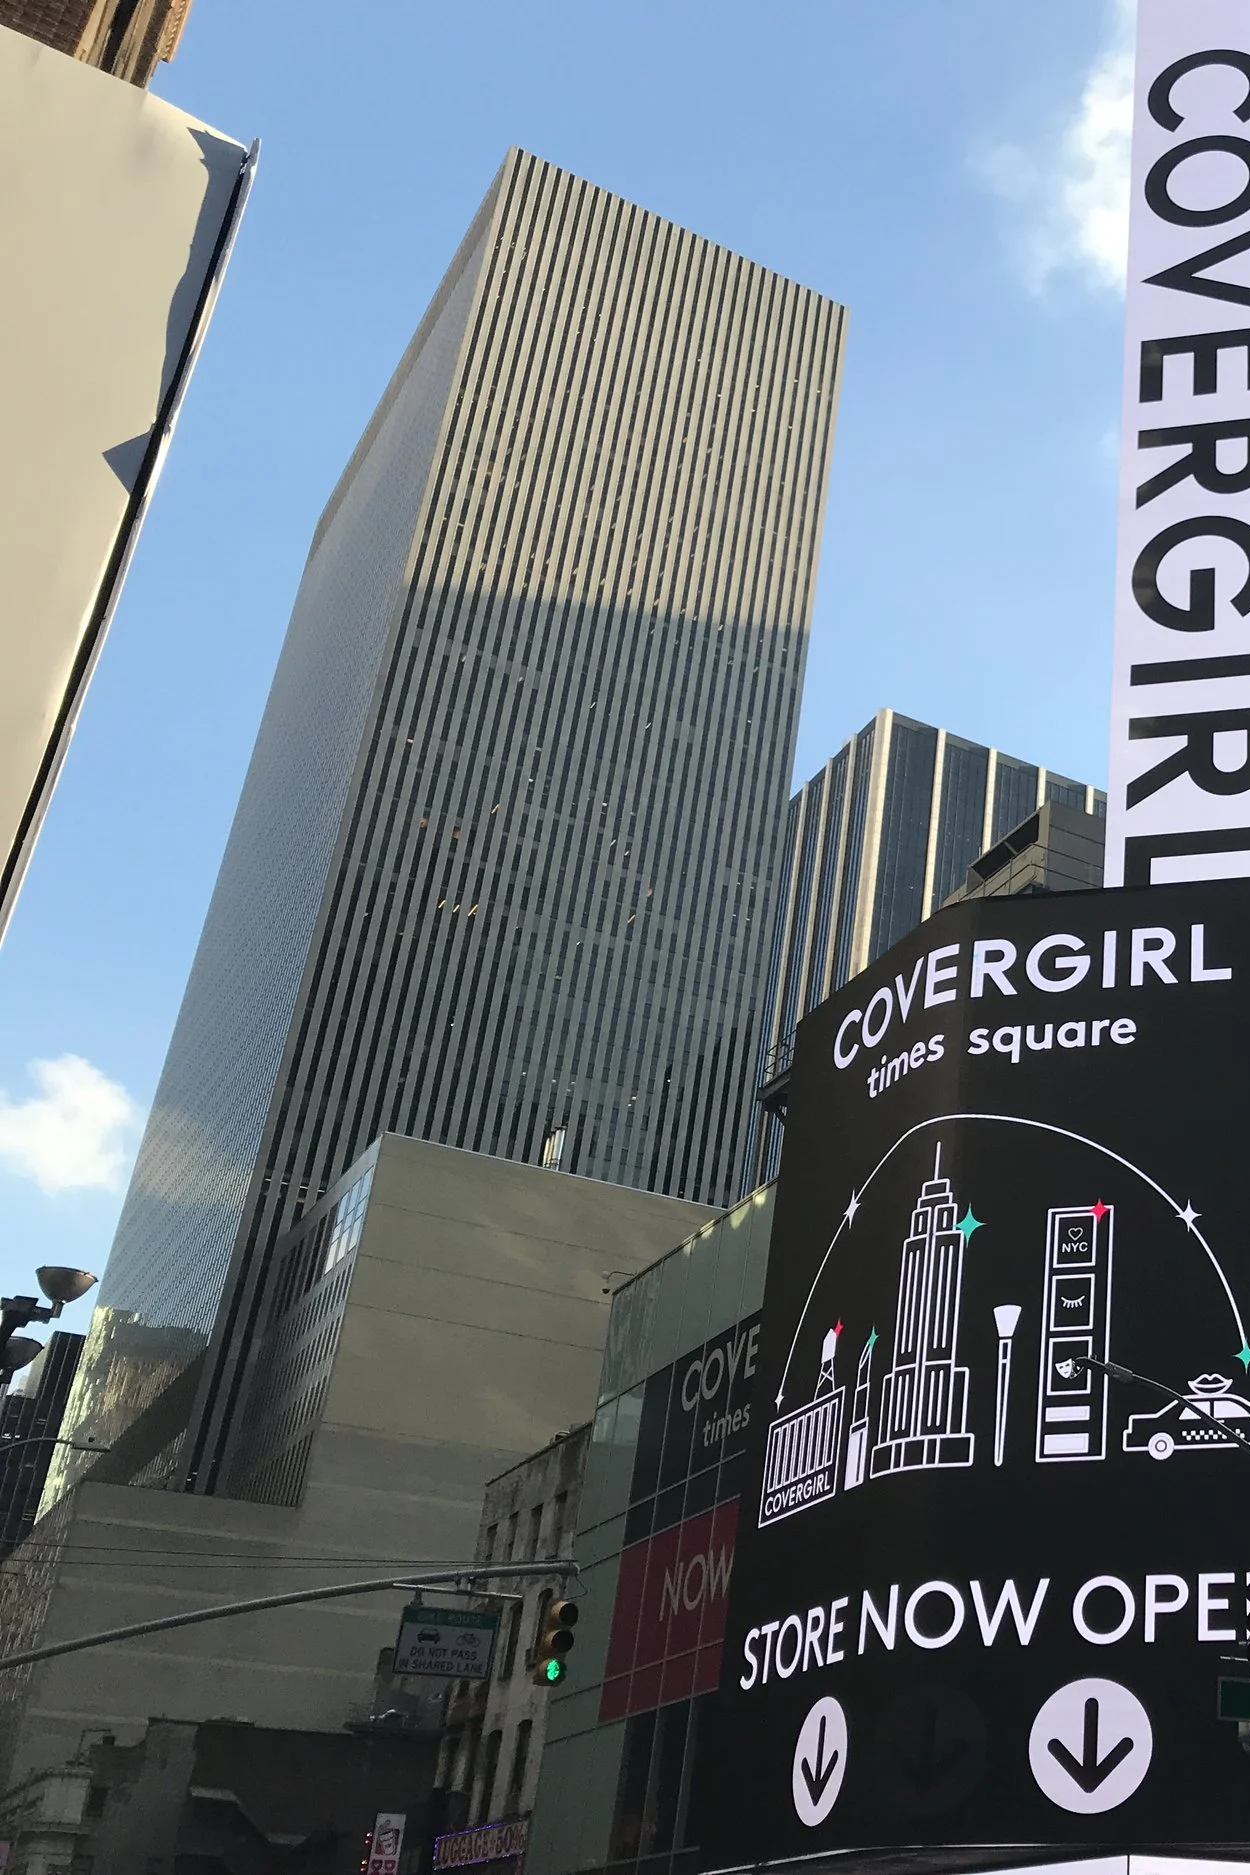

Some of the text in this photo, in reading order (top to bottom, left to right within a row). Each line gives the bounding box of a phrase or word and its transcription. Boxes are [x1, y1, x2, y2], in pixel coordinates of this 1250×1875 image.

[834, 924, 1232, 1070] COVERGIRL
[867, 1016, 1137, 1099] times square
[1062, 1240, 1089, 1254] NYC
[702, 1402, 751, 1448] times
[764, 1477, 832, 1518] COVERGIRL
[659, 1543, 735, 1622] NOW
[410, 1646, 478, 1661] DO NOT PASS
[740, 1596, 849, 1691] STORE
[857, 1577, 1050, 1655] NOW
[399, 1658, 484, 1674] IN SHARED LANE
